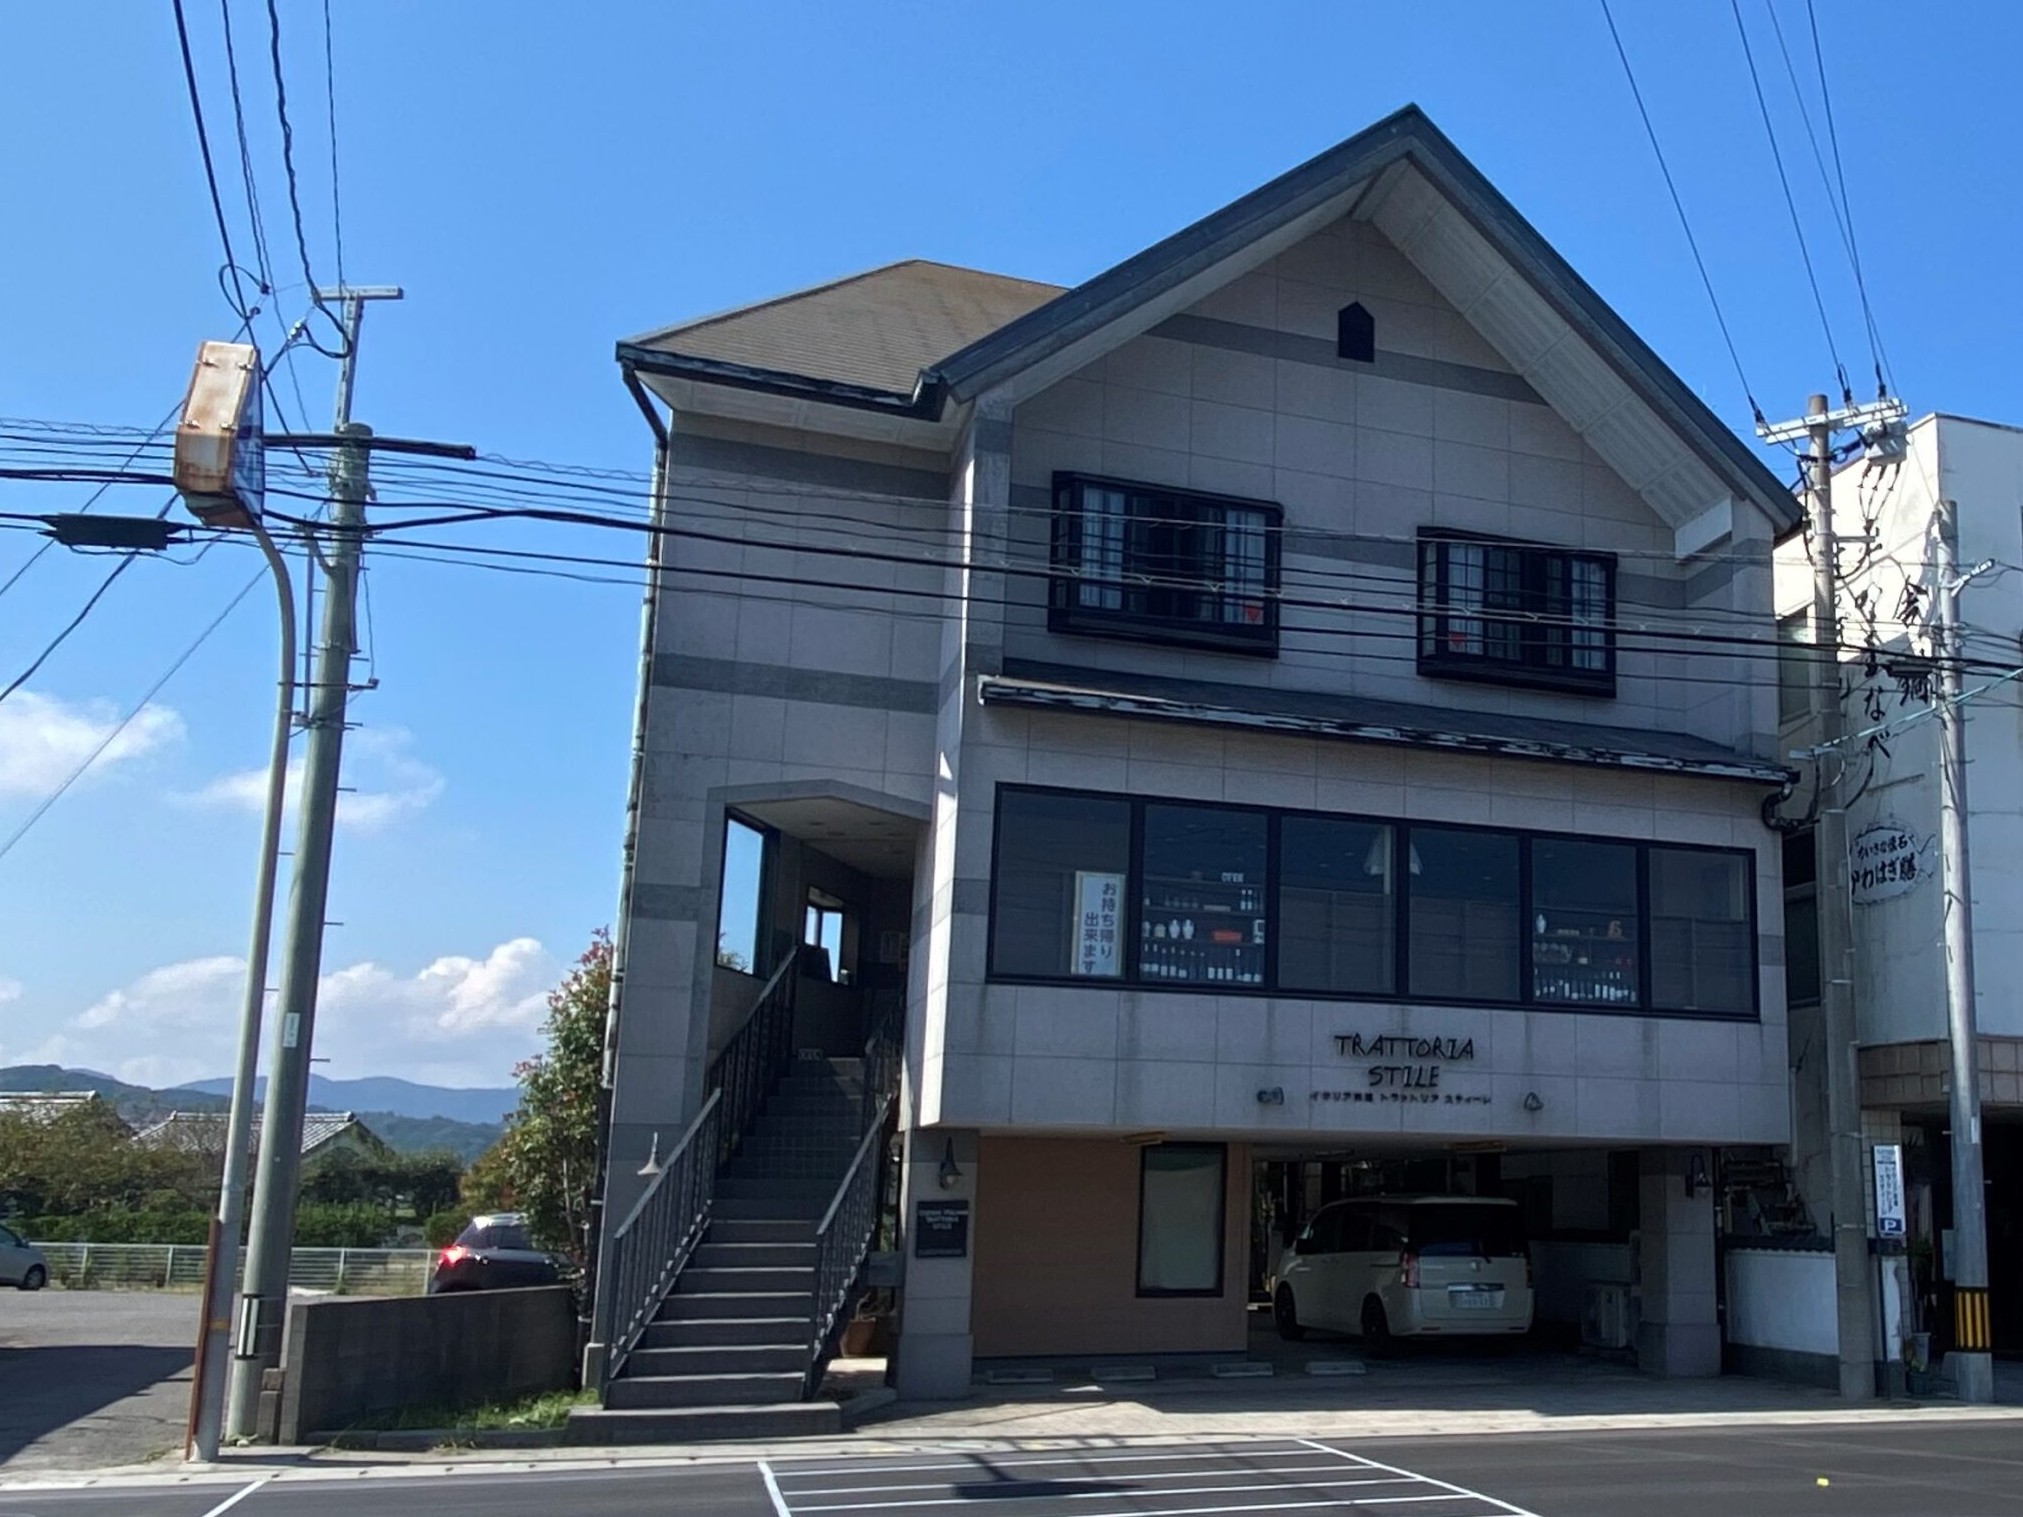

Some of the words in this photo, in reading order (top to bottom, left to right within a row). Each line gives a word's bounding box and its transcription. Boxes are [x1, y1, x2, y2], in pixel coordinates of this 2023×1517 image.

[1100, 882, 1117, 959] お持ち帰り
[1082, 911, 1099, 974] 出来ます
[1333, 1032, 1475, 1060] TRATTORIA
[1368, 1065, 1440, 1088] STILE
[1884, 1220, 1897, 1232] P
